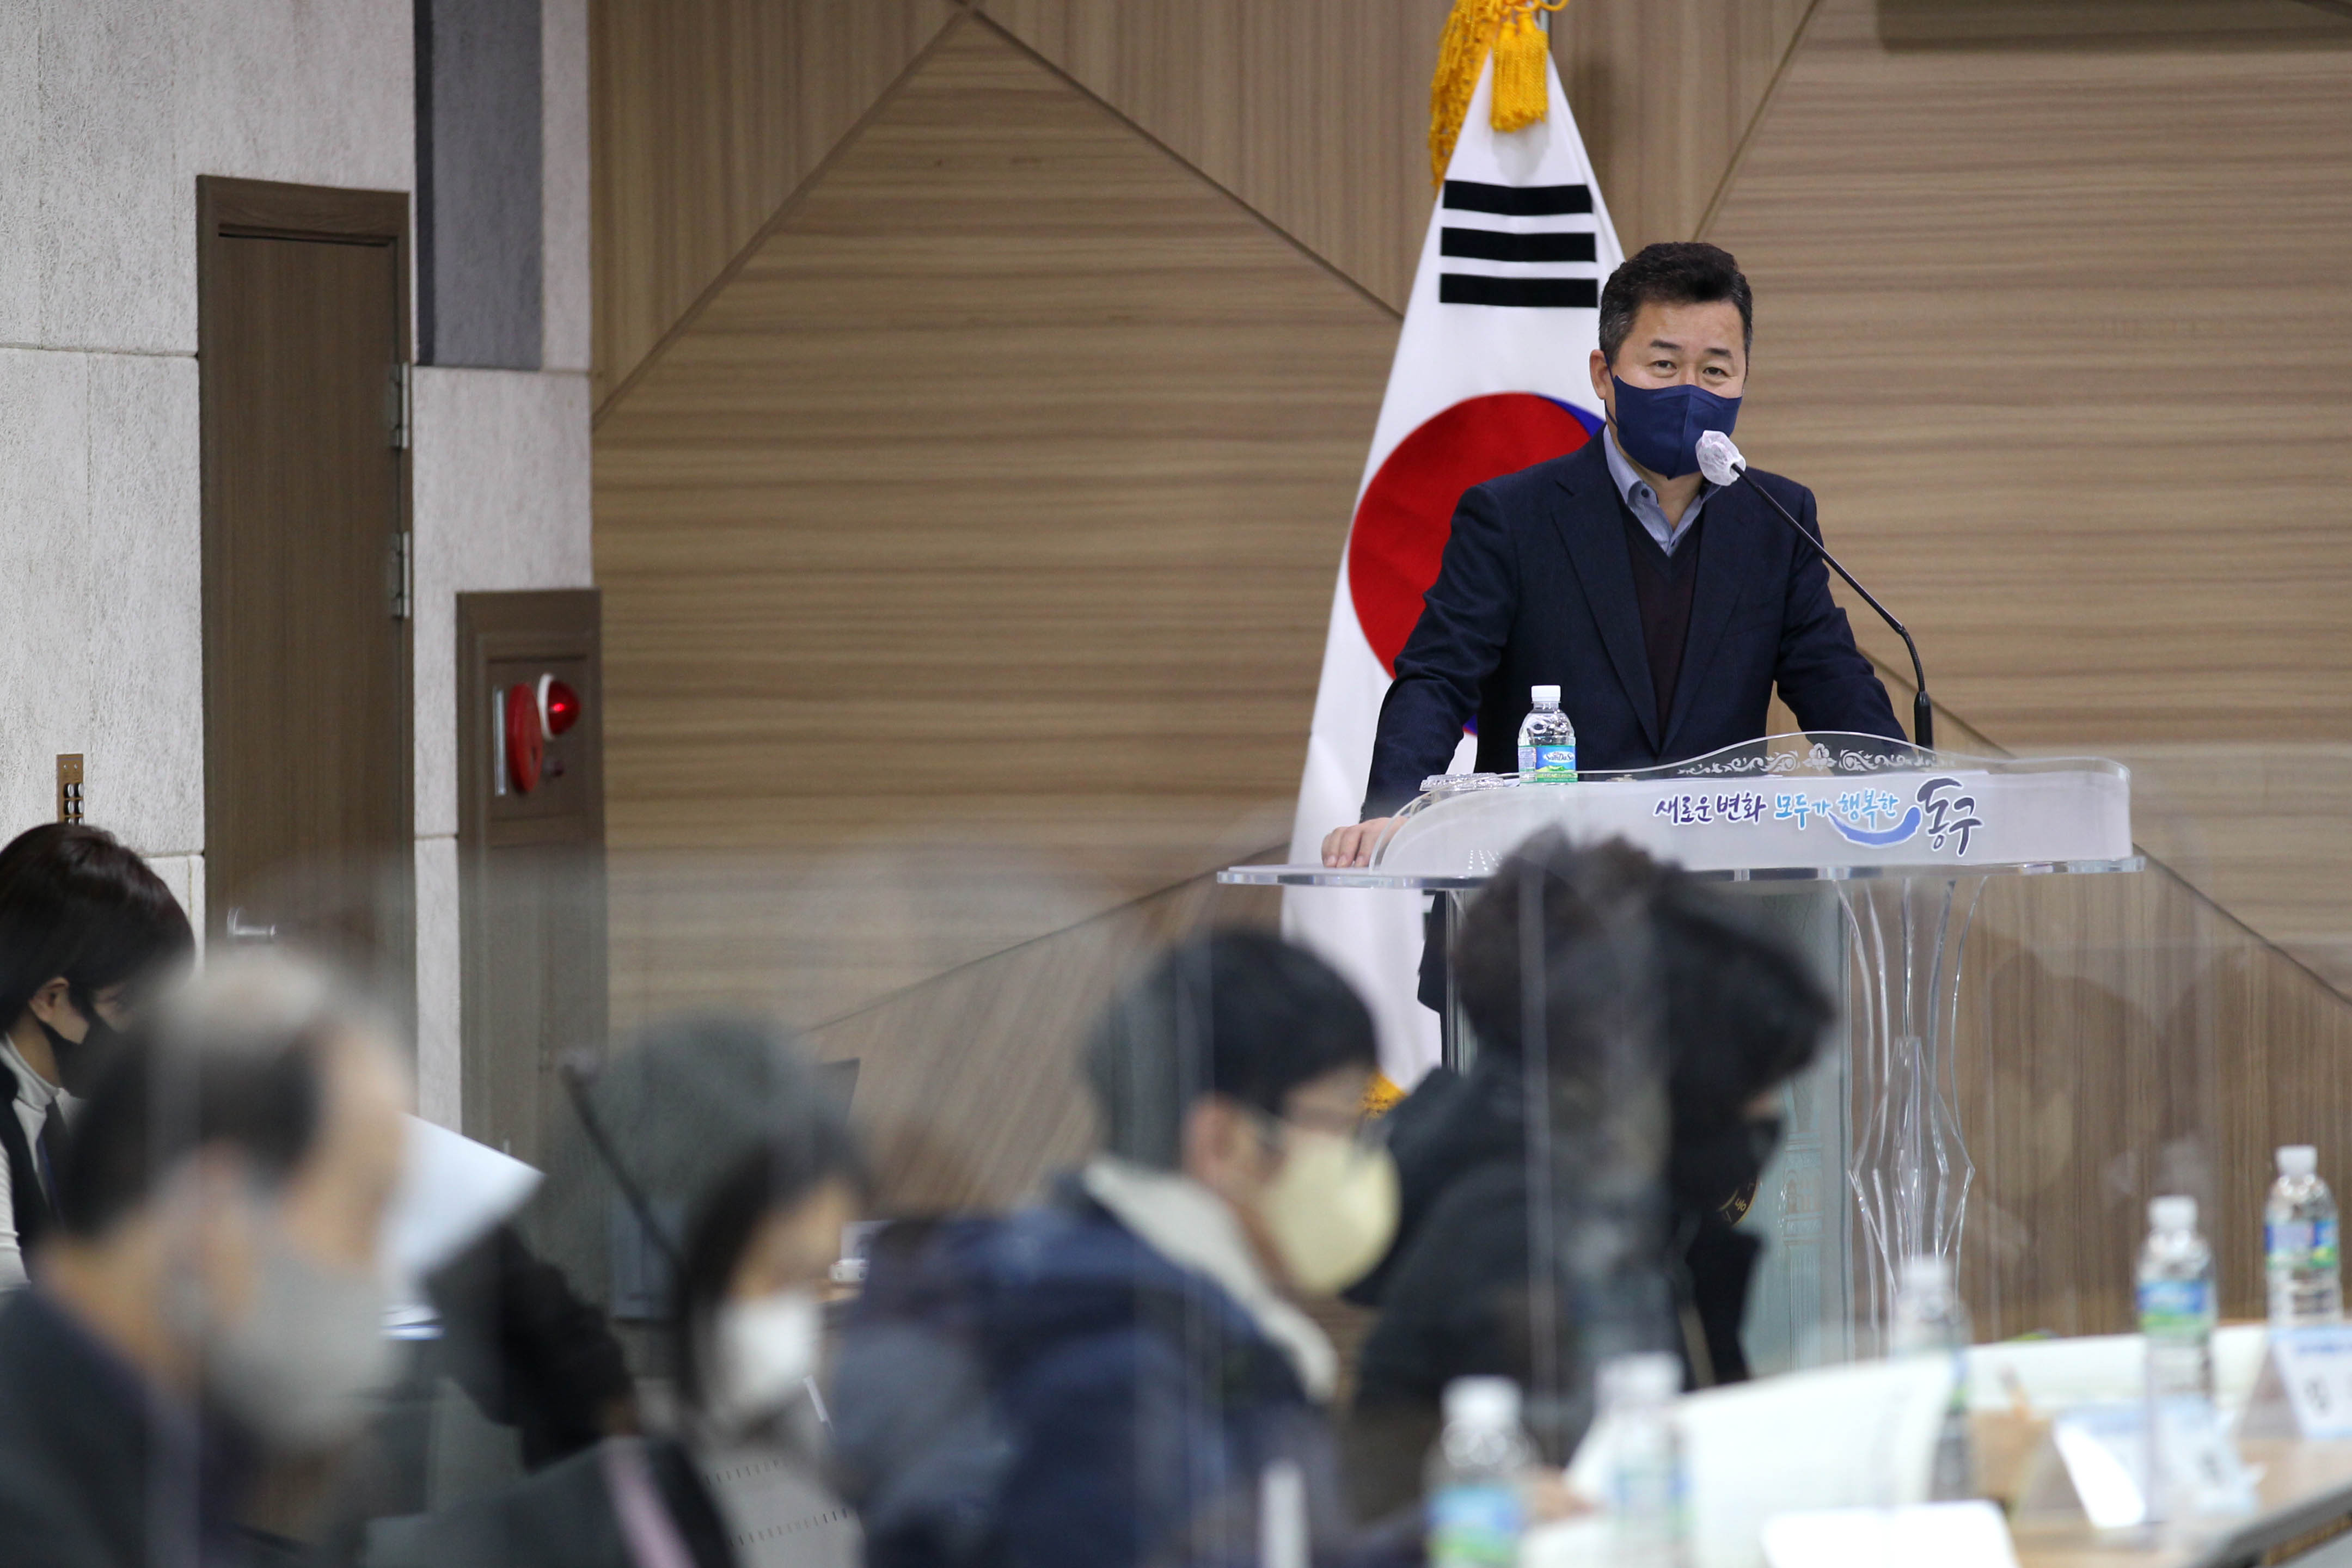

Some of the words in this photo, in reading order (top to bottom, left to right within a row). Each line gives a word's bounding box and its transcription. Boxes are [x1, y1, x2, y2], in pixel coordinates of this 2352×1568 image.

[1654, 794, 1714, 824] 새로운
[1716, 792, 1768, 823] 변화
[1775, 794, 1832, 829] 모두가
[1837, 788, 1899, 830] 행복한
[1916, 777, 1983, 855] 동구
